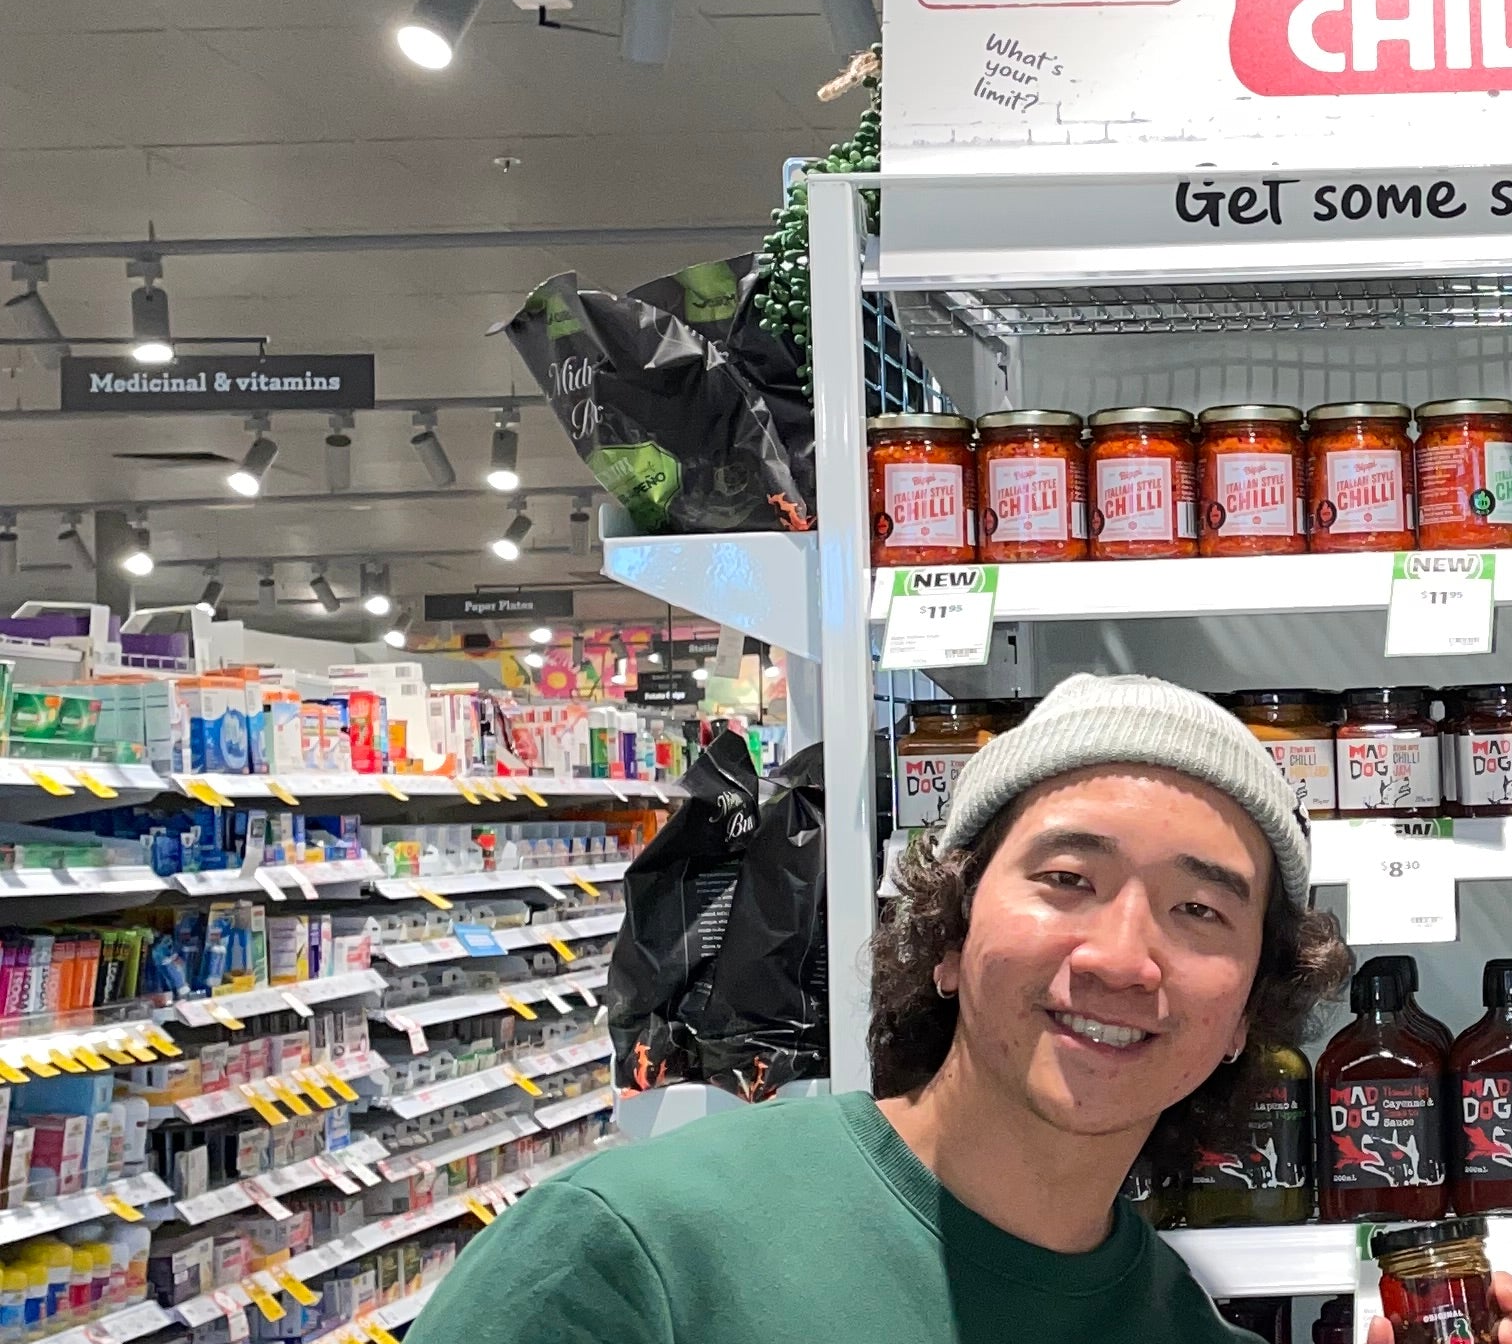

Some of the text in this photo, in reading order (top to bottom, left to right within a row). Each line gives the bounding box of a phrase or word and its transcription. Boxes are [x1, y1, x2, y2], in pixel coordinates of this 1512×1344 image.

[986, 32, 1064, 76] What's
[984, 59, 1038, 85] your
[973, 76, 1039, 114] limit?
[1175, 162, 1300, 227] Get
[1313, 178, 1467, 223] some
[89, 369, 341, 394] Medicinal & vitamins
[1226, 473, 1285, 492] ITALIAN STYLE
[1336, 470, 1395, 492] ITALIAN STYLE
[1226, 486, 1285, 514] CHILLI
[1337, 482, 1395, 513] CHILLI
[1413, 556, 1475, 574] NEW
[913, 571, 976, 588] NEW
[464, 600, 534, 613] Paper Plates
[1472, 740, 1511, 756] MAD
[1472, 755, 1512, 775] DOG
[1330, 1085, 1379, 1105] MAD
[1382, 1097, 1434, 1110] Cayenne &
[1330, 1105, 1380, 1132] DOG
[1383, 1117, 1415, 1128] Sauce
